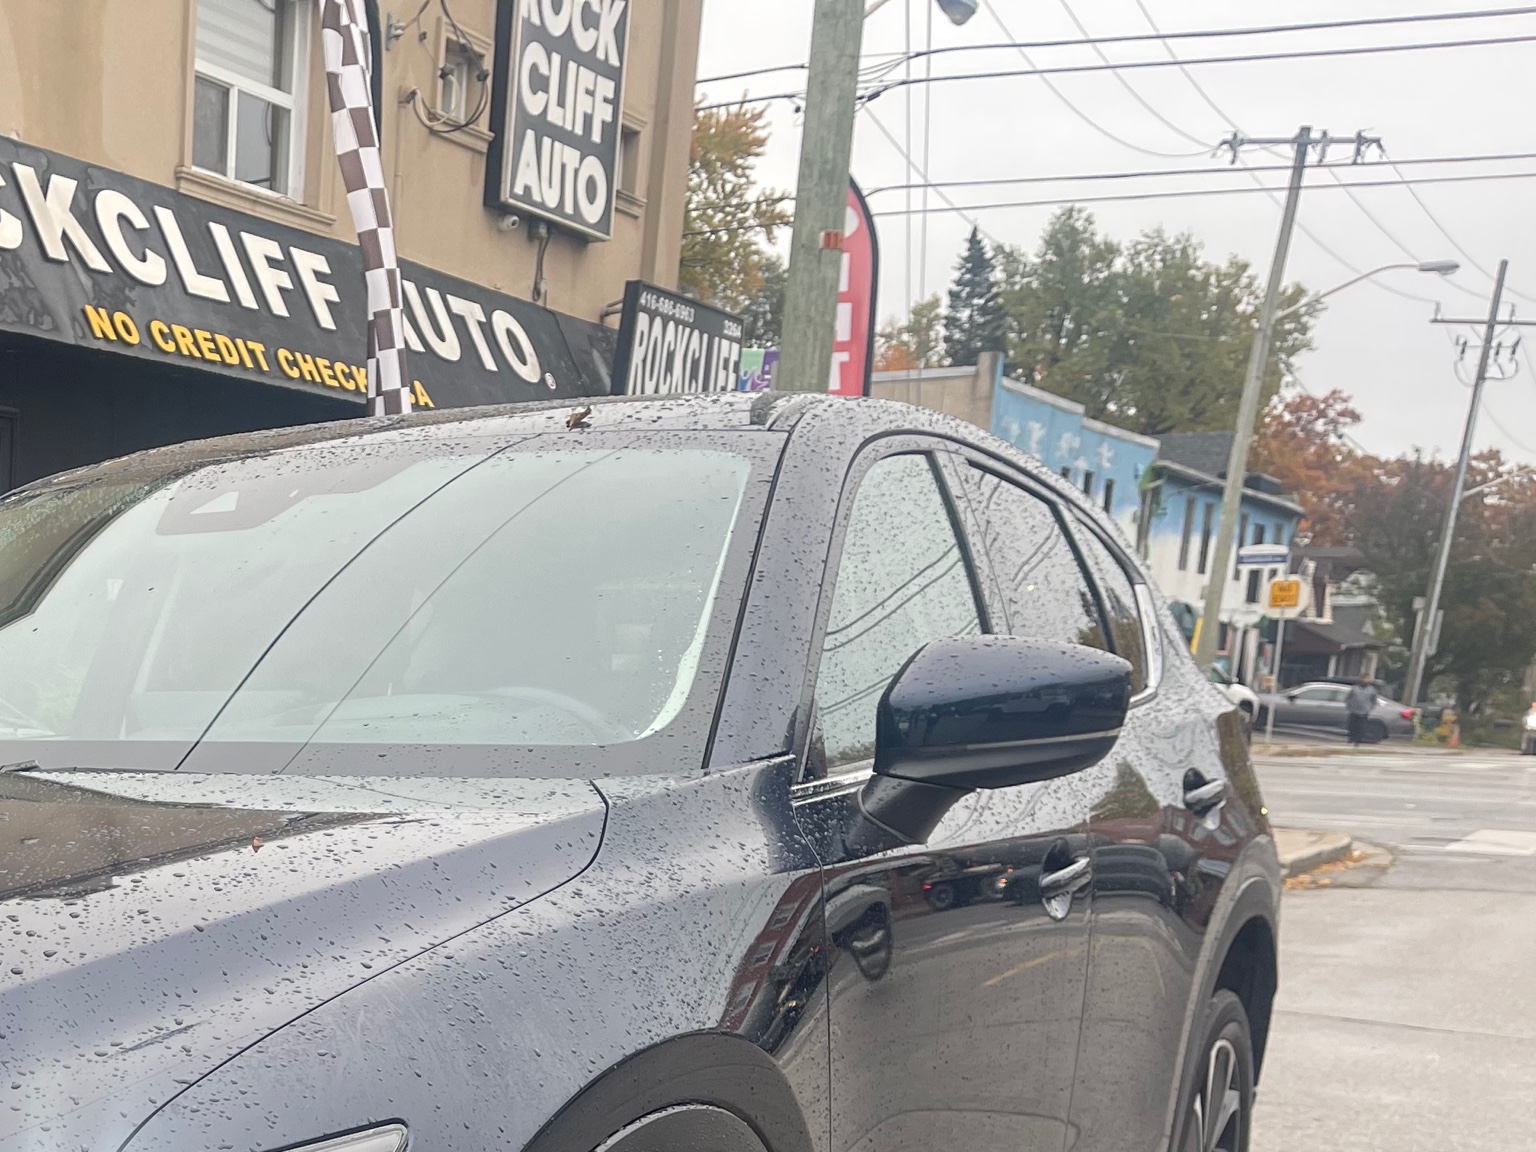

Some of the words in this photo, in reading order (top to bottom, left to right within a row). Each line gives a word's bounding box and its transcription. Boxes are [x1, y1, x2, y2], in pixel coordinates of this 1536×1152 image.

[521, 41, 615, 144] CLIFF
[514, 128, 607, 224] AUTO
[84, 304, 141, 346] NO
[148, 320, 271, 371] CREDIT
[277, 347, 367, 393] CHECK
[627, 312, 741, 396] ROCKCLIFF
